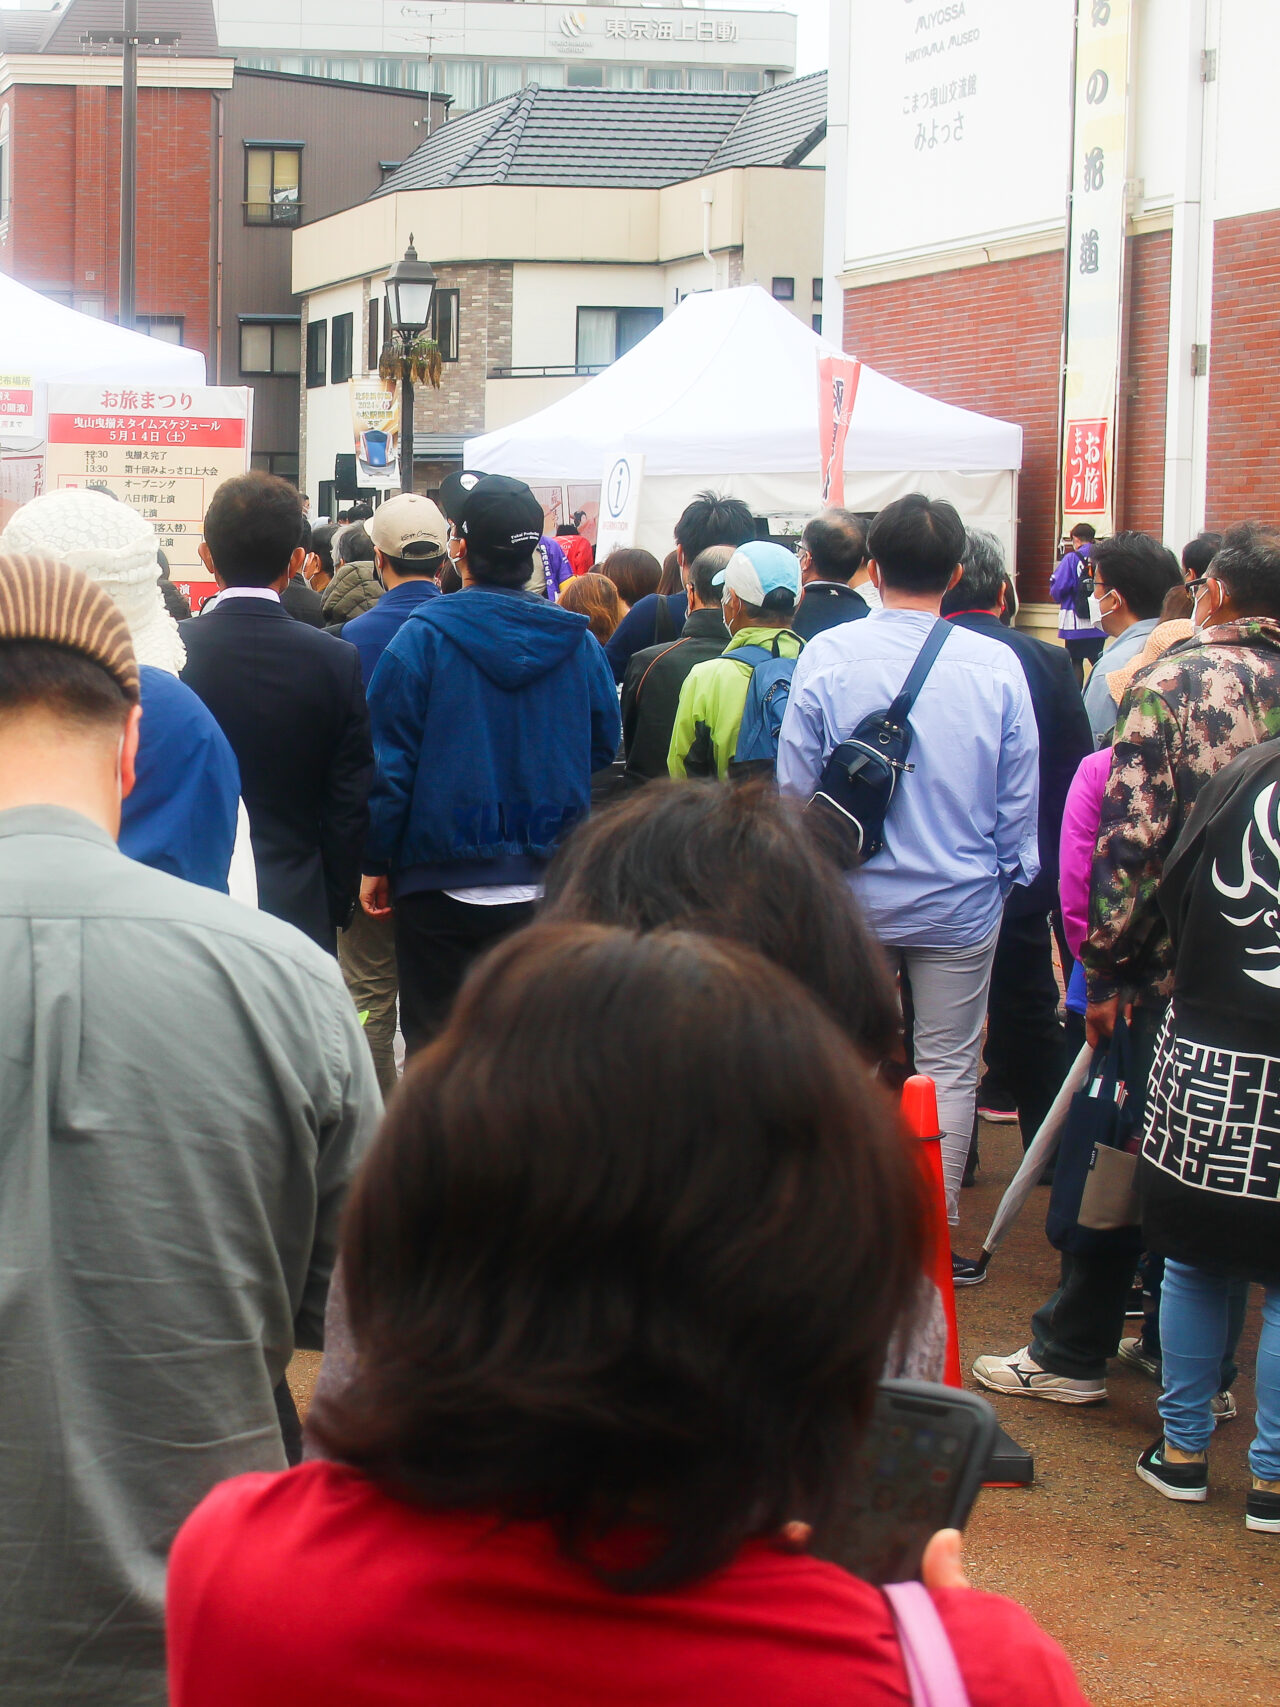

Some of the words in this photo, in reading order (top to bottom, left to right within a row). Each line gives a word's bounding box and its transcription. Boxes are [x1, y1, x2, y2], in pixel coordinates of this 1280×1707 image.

[914, 2, 966, 34] MIYOSSA
[605, 18, 741, 43] 東京海上日動
[902, 74, 977, 115] こまつ曳山交流館
[914, 111, 965, 151] みよっさ
[100, 390, 193, 411] お旅まつり
[74, 417, 221, 432] 曳山曳揃えタイムスケジュール
[125, 451, 167, 460] 曳揃え完了
[124, 480, 176, 489] オープニング
